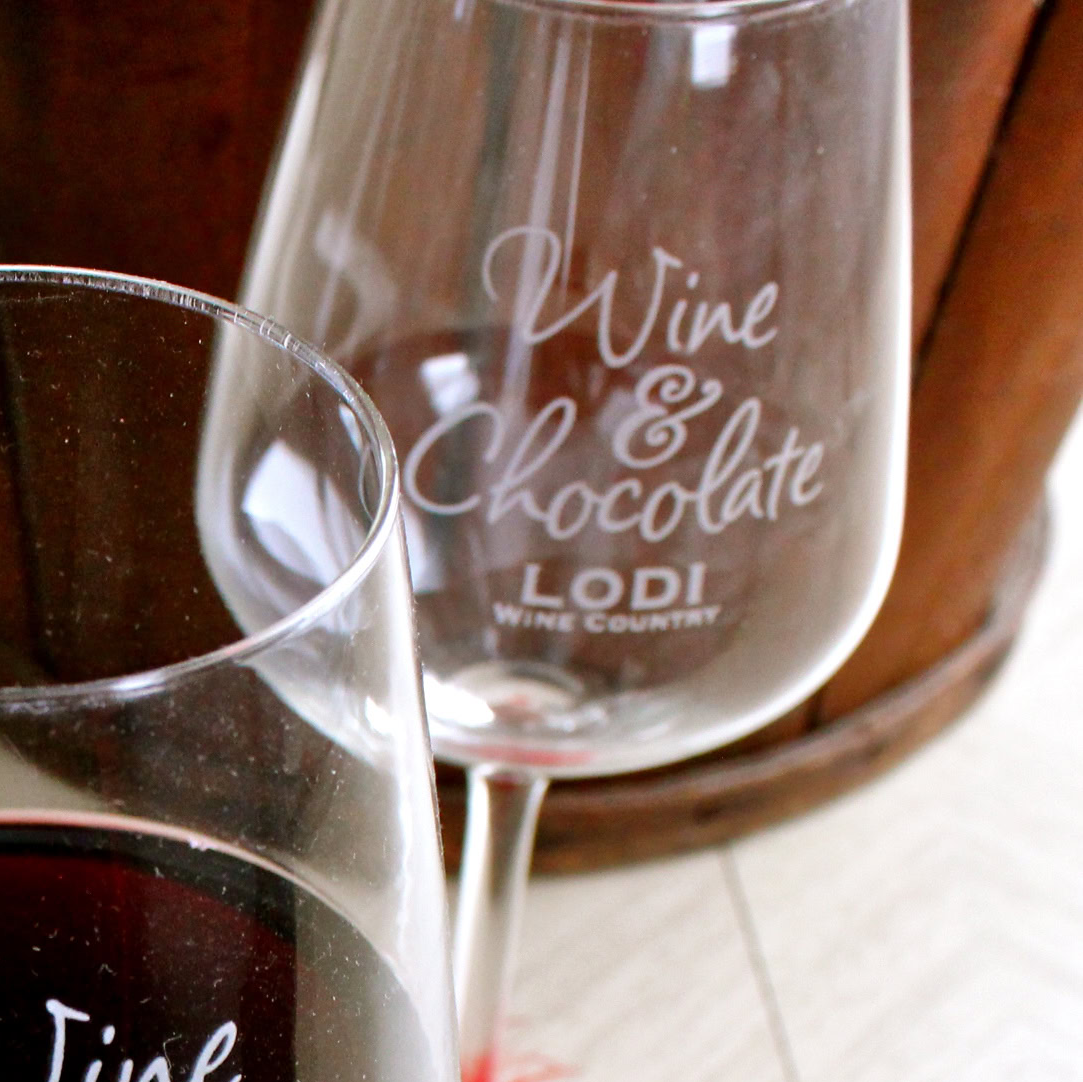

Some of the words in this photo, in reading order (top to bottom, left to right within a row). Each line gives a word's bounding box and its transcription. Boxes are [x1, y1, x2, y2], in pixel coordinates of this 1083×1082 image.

[482, 225, 780, 369] Wine
[403, 397, 824, 543] Chocolate
[612, 364, 723, 470] &
[492, 601, 575, 633] WINE
[582, 604, 722, 634] COUNTRY
[520, 561, 707, 612] LODI
